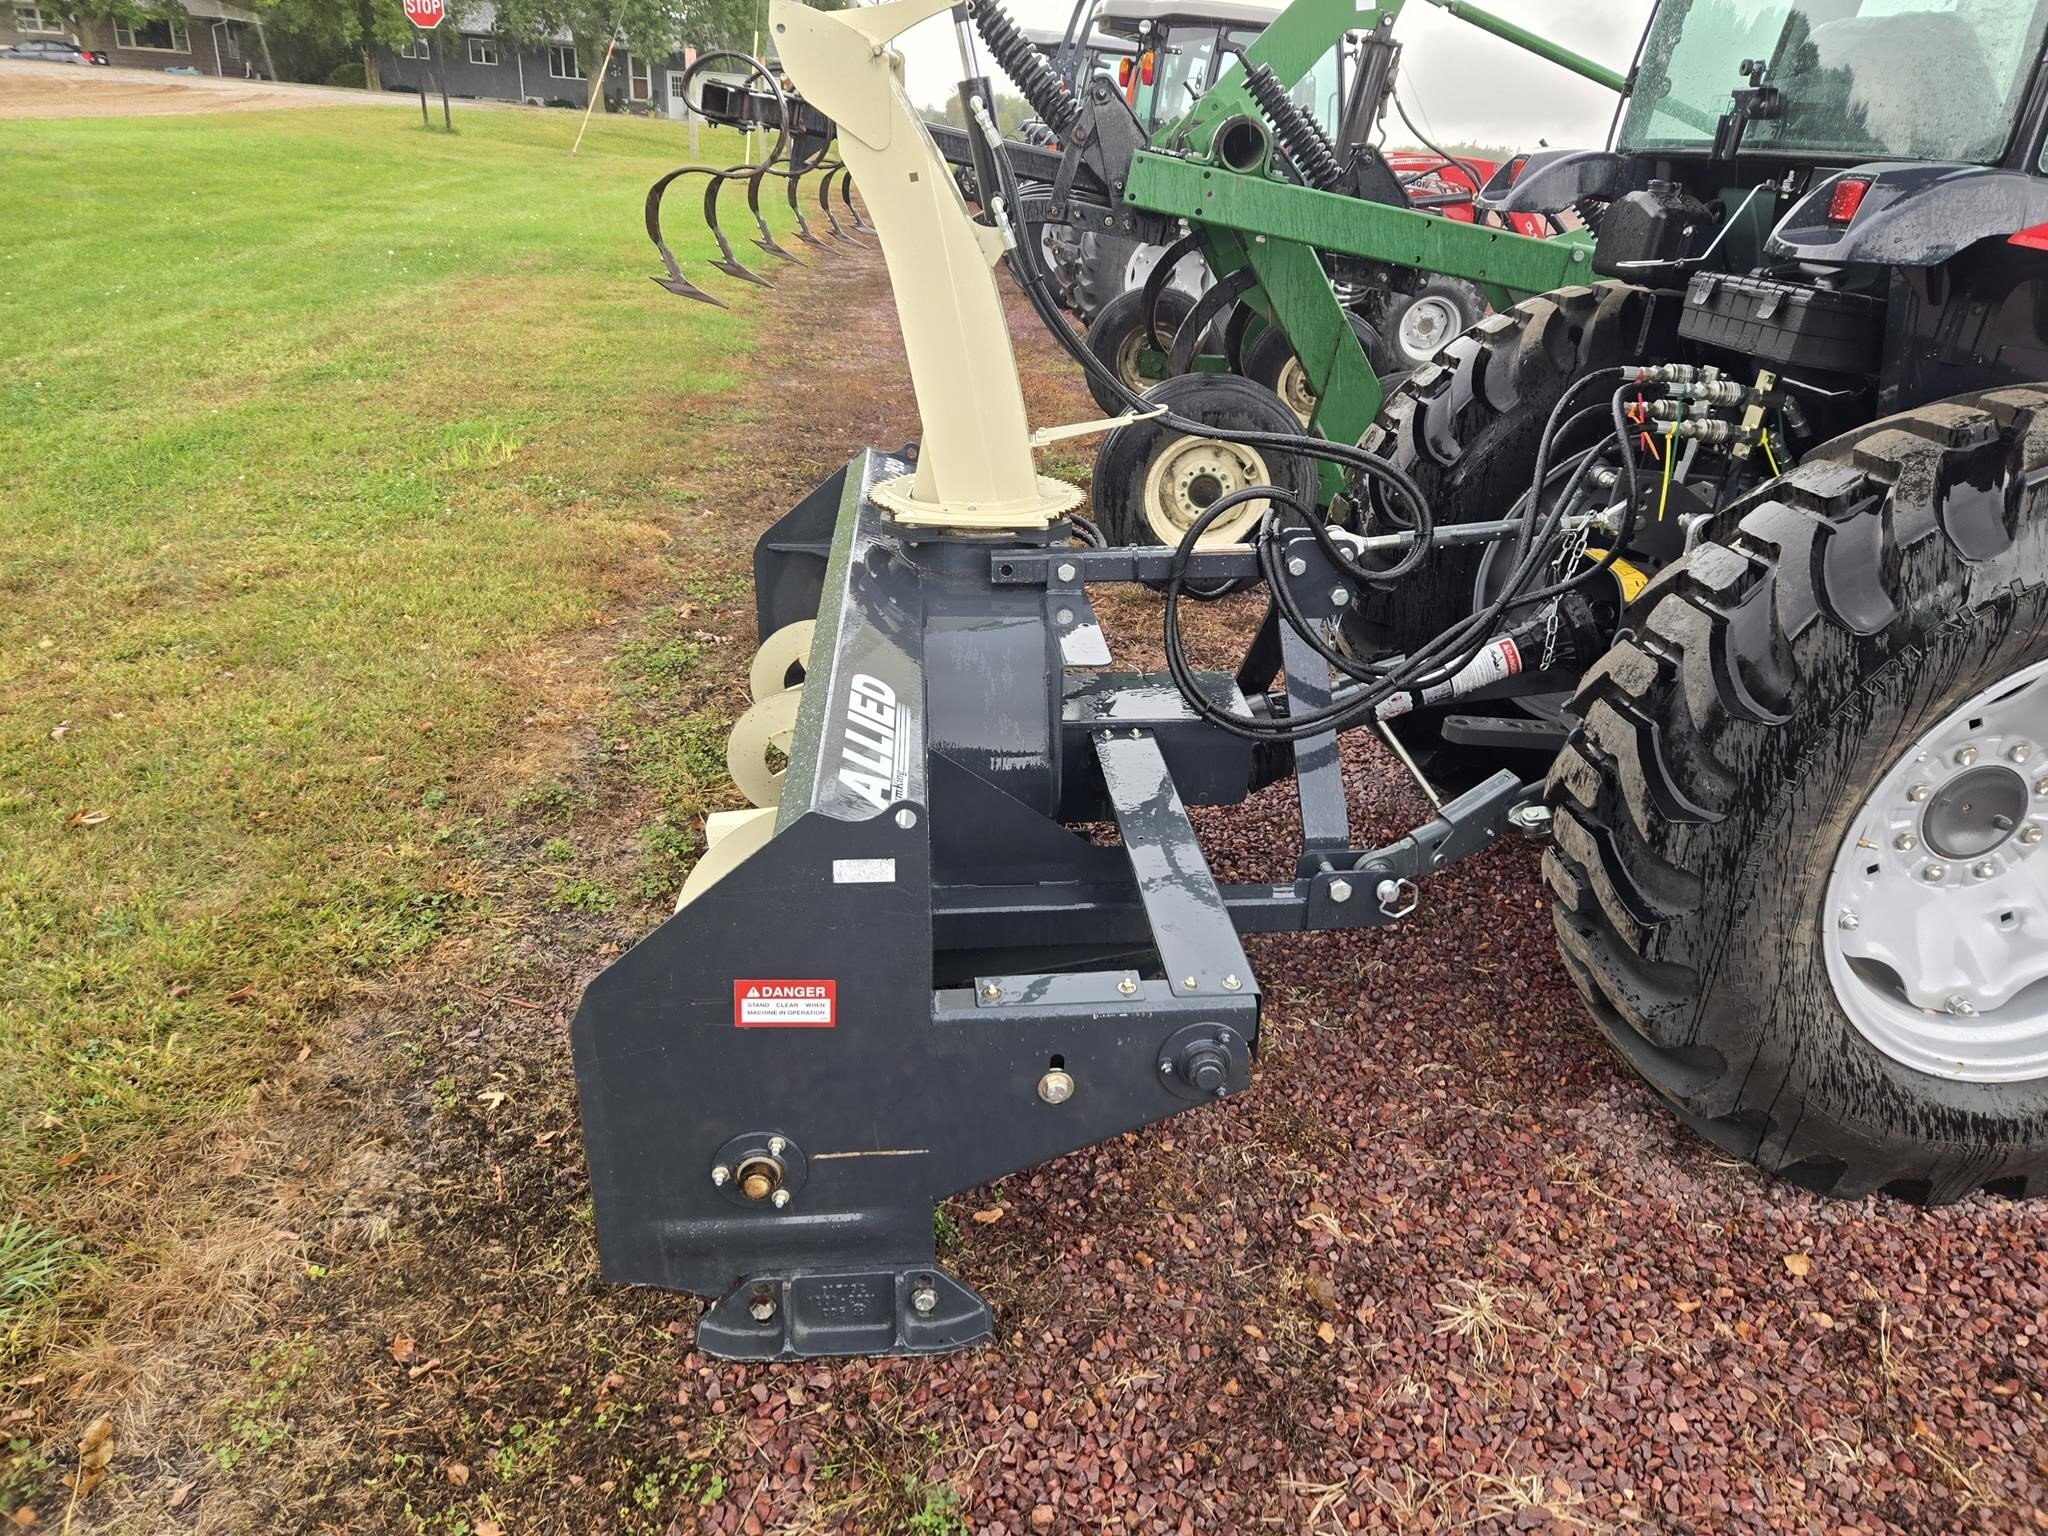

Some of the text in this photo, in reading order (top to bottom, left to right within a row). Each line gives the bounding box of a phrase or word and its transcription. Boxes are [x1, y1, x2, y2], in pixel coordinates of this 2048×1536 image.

[406, 0, 441, 15] STOP
[838, 673, 896, 811] ALLIED
[762, 986, 825, 997] DANGER
